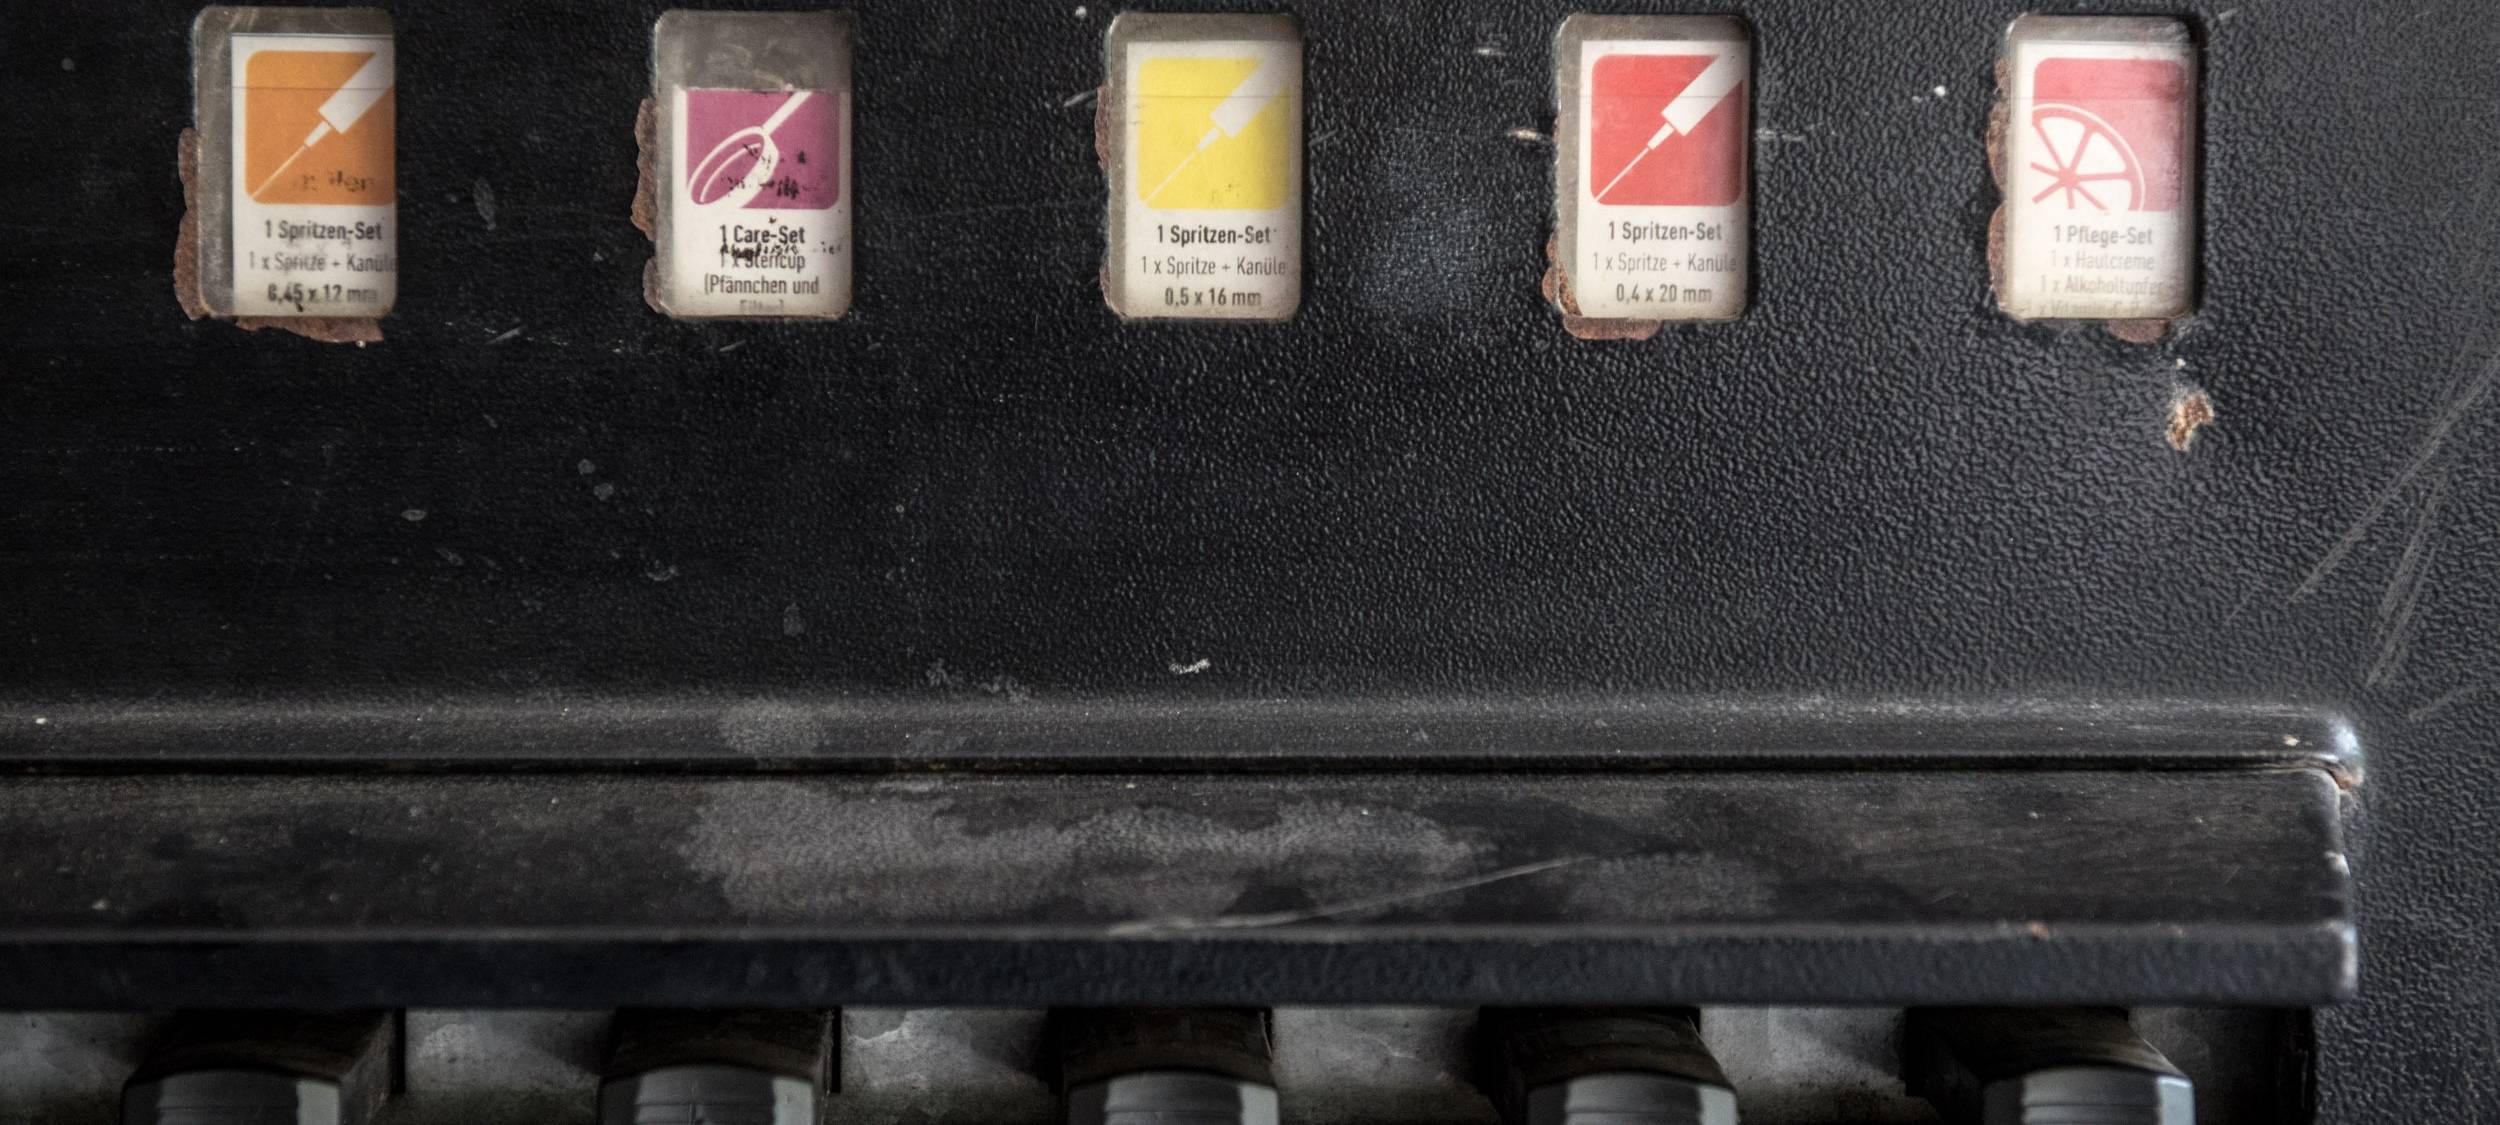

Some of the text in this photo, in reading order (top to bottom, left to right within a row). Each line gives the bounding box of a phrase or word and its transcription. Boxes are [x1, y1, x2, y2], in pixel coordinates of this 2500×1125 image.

[265, 219, 383, 243] 1 Spritzen-Set
[719, 224, 806, 244] 1 Care-Set
[1157, 224, 1271, 248] 1 Spritzen-Set
[1608, 220, 1723, 244] 1 Spritzen-Set
[2054, 225, 2153, 249] 1 Pflege-Set
[249, 251, 255, 271] 1
[262, 257, 270, 271] x
[274, 252, 326, 275] Spritze
[331, 259, 341, 268] +
[745, 250, 806, 273] Stericup
[1141, 256, 1287, 278] 1 x Spritze + Kanüle
[1593, 252, 1737, 275] 1 x Spritze + Kanüle
[2063, 256, 2071, 269] x
[2076, 251, 2155, 271] Hautcreme
[308, 288, 317, 301] x
[323, 283, 343, 301] 12
[347, 288, 378, 302] mm
[704, 273, 819, 295] (Pfännchen und
[1616, 284, 1713, 304] 0,4 x 20 mm
[2053, 280, 2060, 293] x
[1164, 287, 1262, 307] 0,5 x 16 mm
